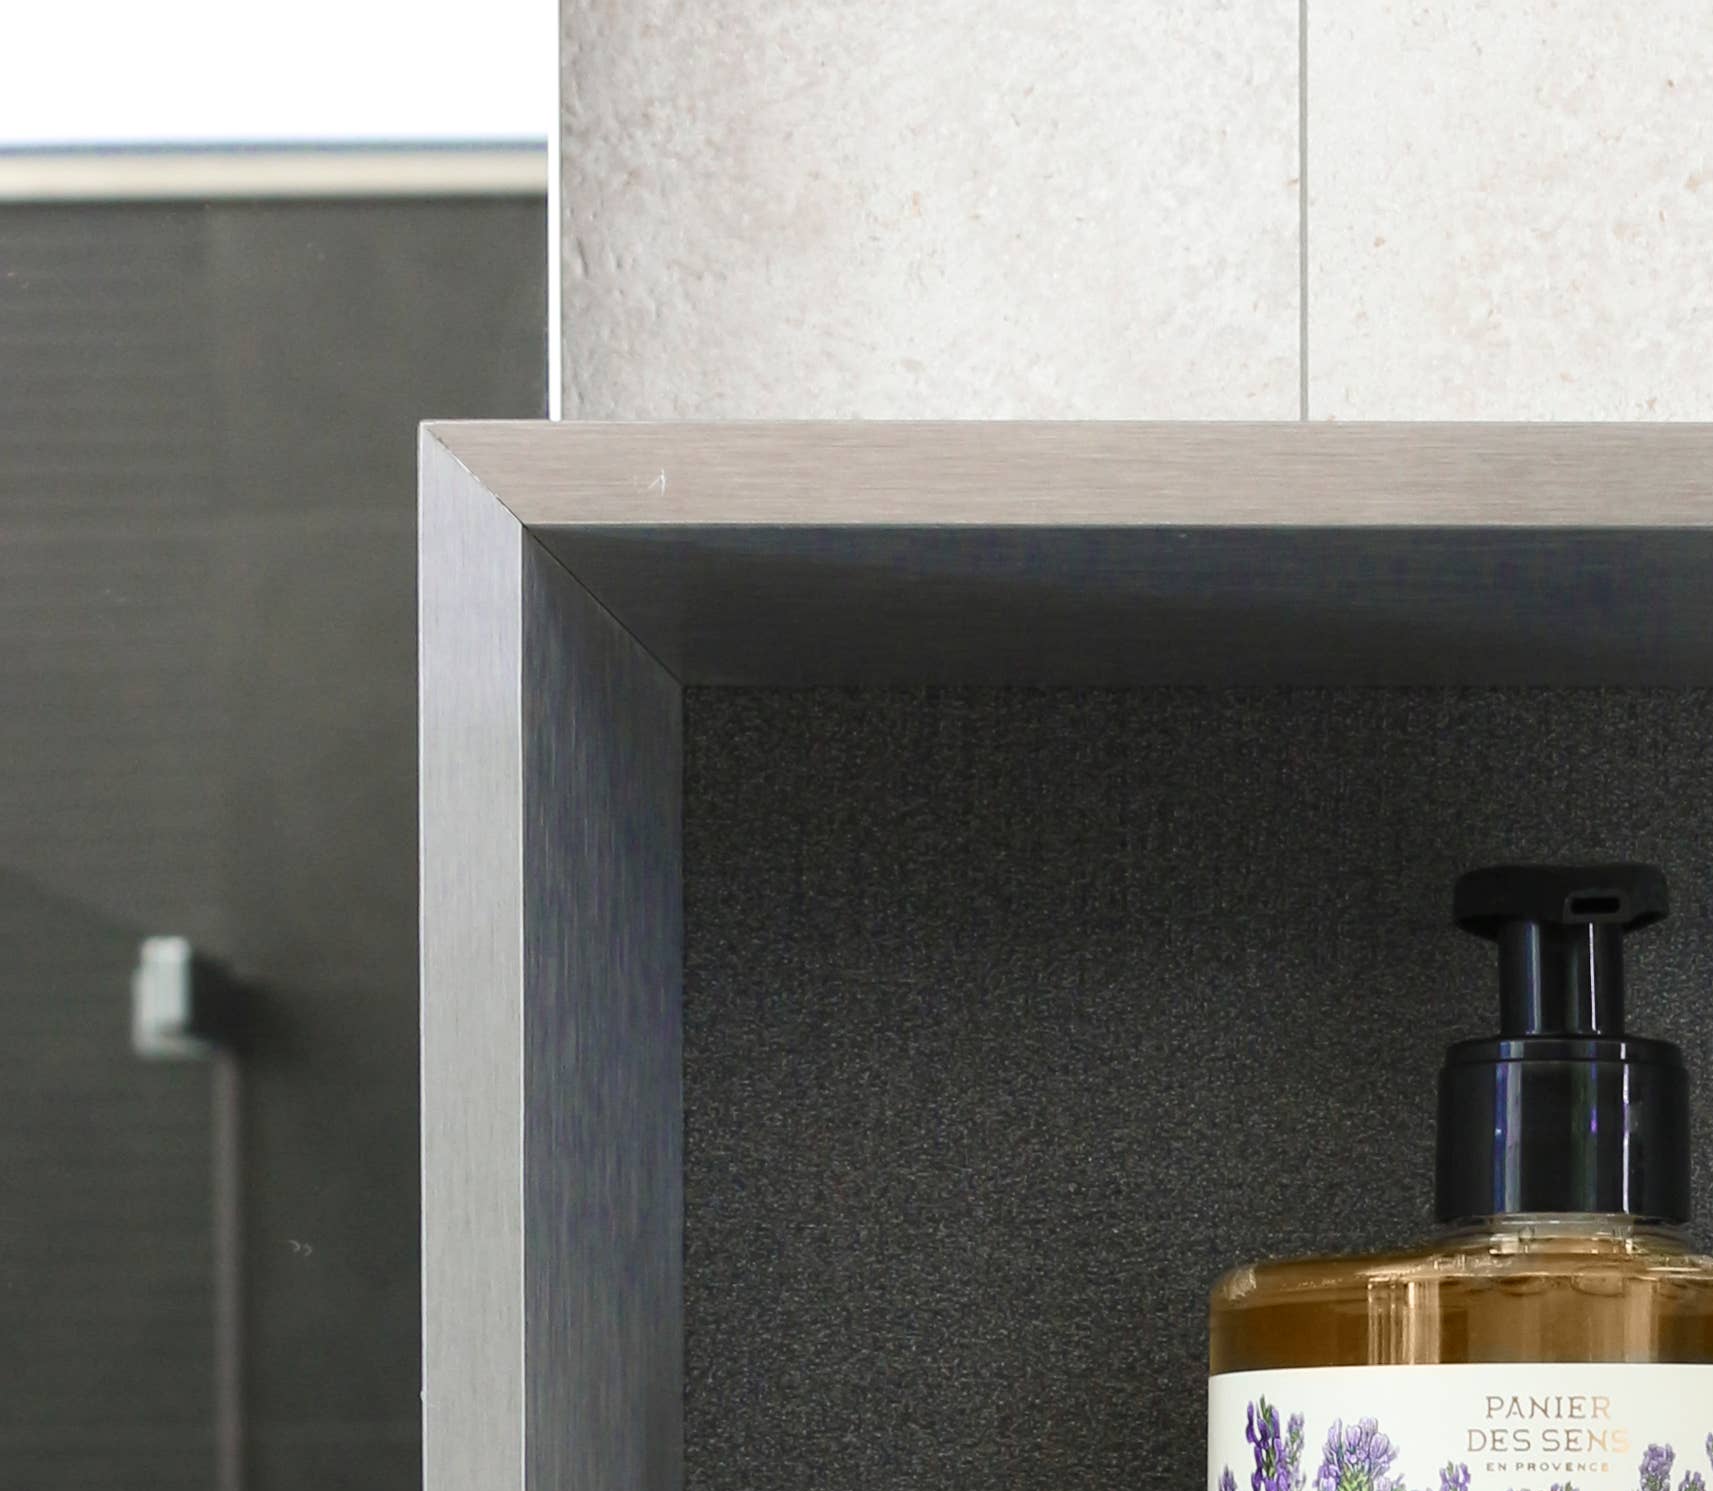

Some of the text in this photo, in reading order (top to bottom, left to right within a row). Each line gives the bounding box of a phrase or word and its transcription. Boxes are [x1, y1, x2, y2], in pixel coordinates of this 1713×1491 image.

[1486, 1396, 1610, 1418] PANIER
[1467, 1429, 1630, 1452] DES SENS
[1486, 1462, 1609, 1472] EN PROVENCE
